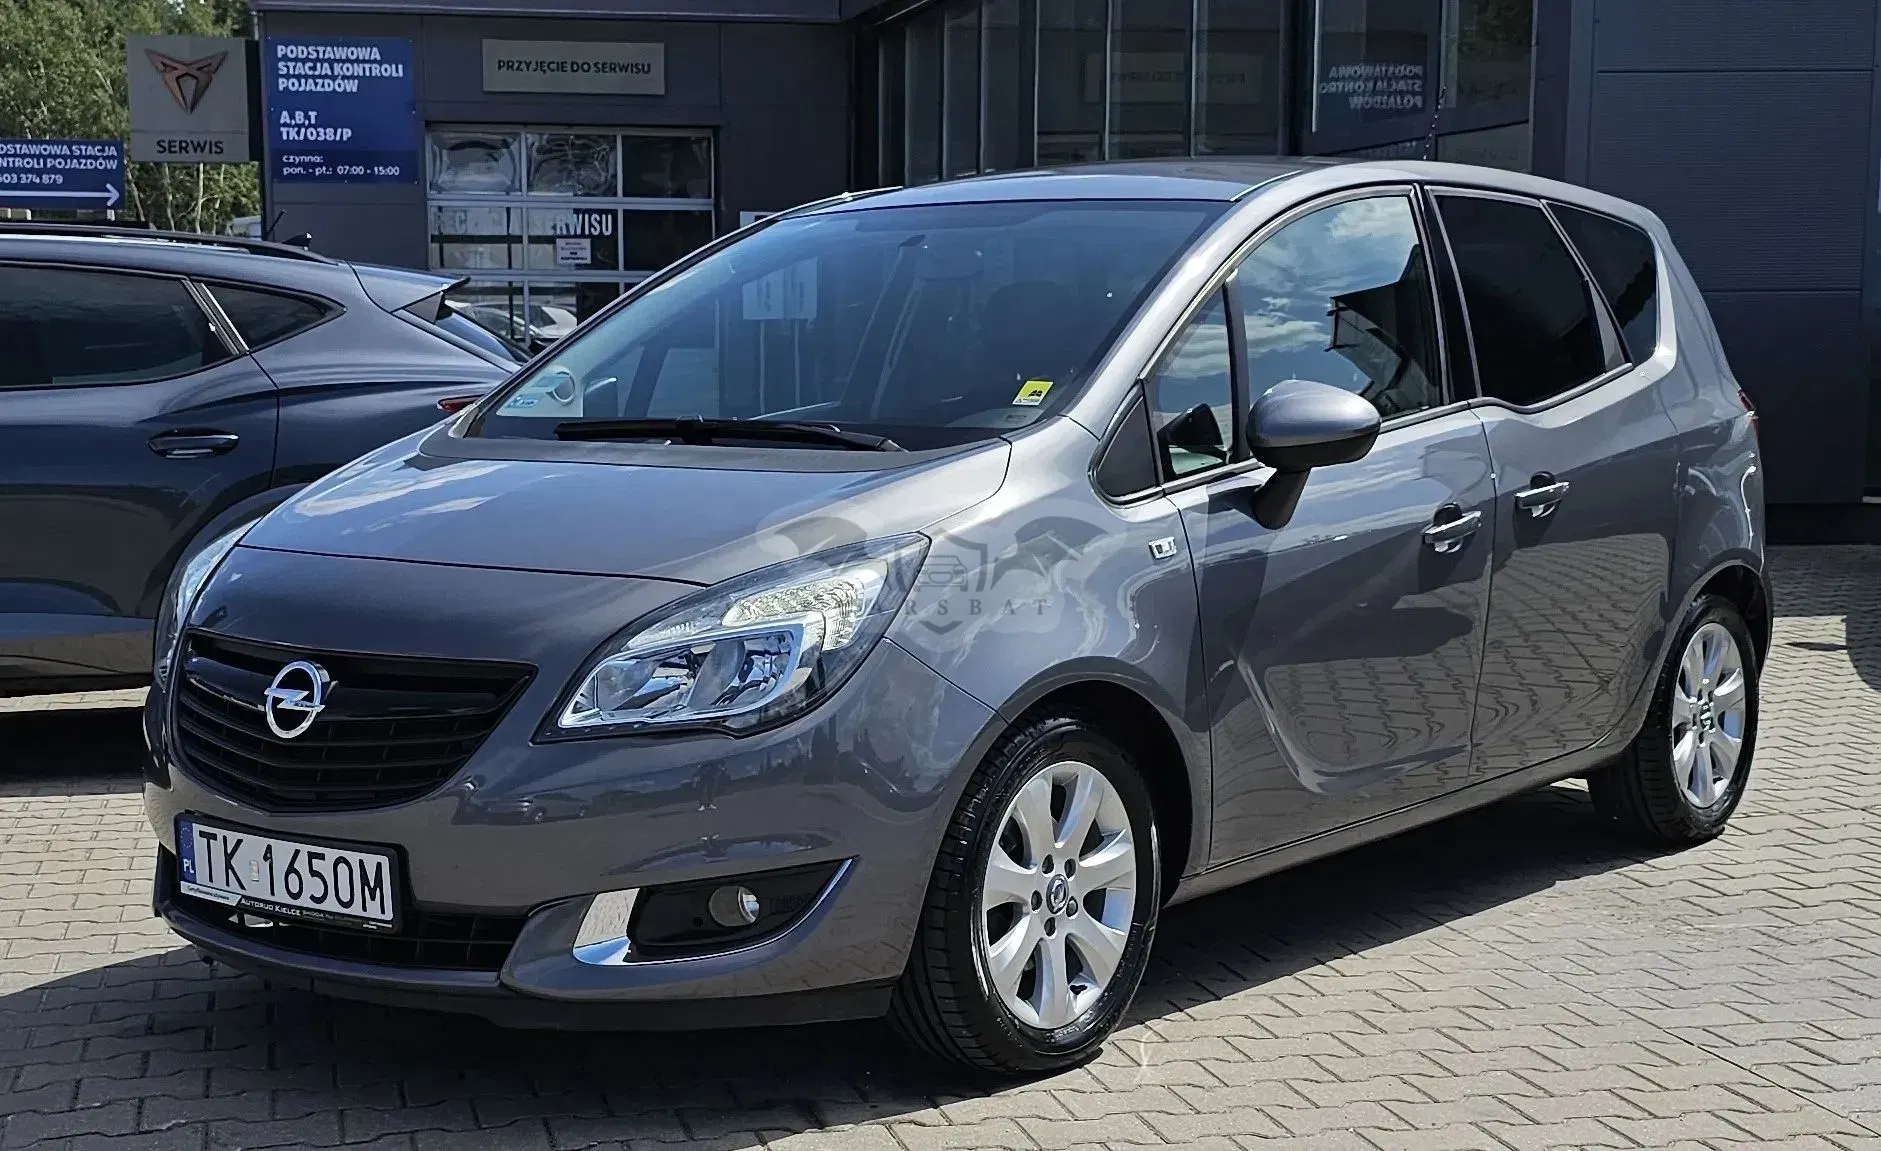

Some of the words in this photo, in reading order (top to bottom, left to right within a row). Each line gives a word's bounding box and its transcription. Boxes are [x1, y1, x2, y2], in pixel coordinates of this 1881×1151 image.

[277, 45, 381, 60] PODSTAWOWA
[278, 61, 332, 76] STACJA
[333, 63, 404, 77] KONTROLI
[497, 59, 568, 75] PRZYJĘCIE
[570, 60, 592, 73] DO
[593, 61, 652, 74] SERWISU
[278, 75, 359, 92] POJAZDÓW
[280, 110, 318, 126] A,B,T
[280, 127, 352, 141] TK/038/P
[72, 144, 118, 156] STACJA
[156, 139, 224, 154] SERWIS
[46, 157, 118, 169] POJAZDÓW
[282, 154, 324, 164] czynna:
[283, 166, 307, 176] pon.
[336, 166, 365, 175] 07:00
[374, 166, 400, 175] 15:00
[20, 173, 40, 184] 374
[42, 173, 64, 185] 879
[183, 858, 195, 875] PL
[199, 830, 246, 890] TK
[263, 843, 386, 916] 1650M
